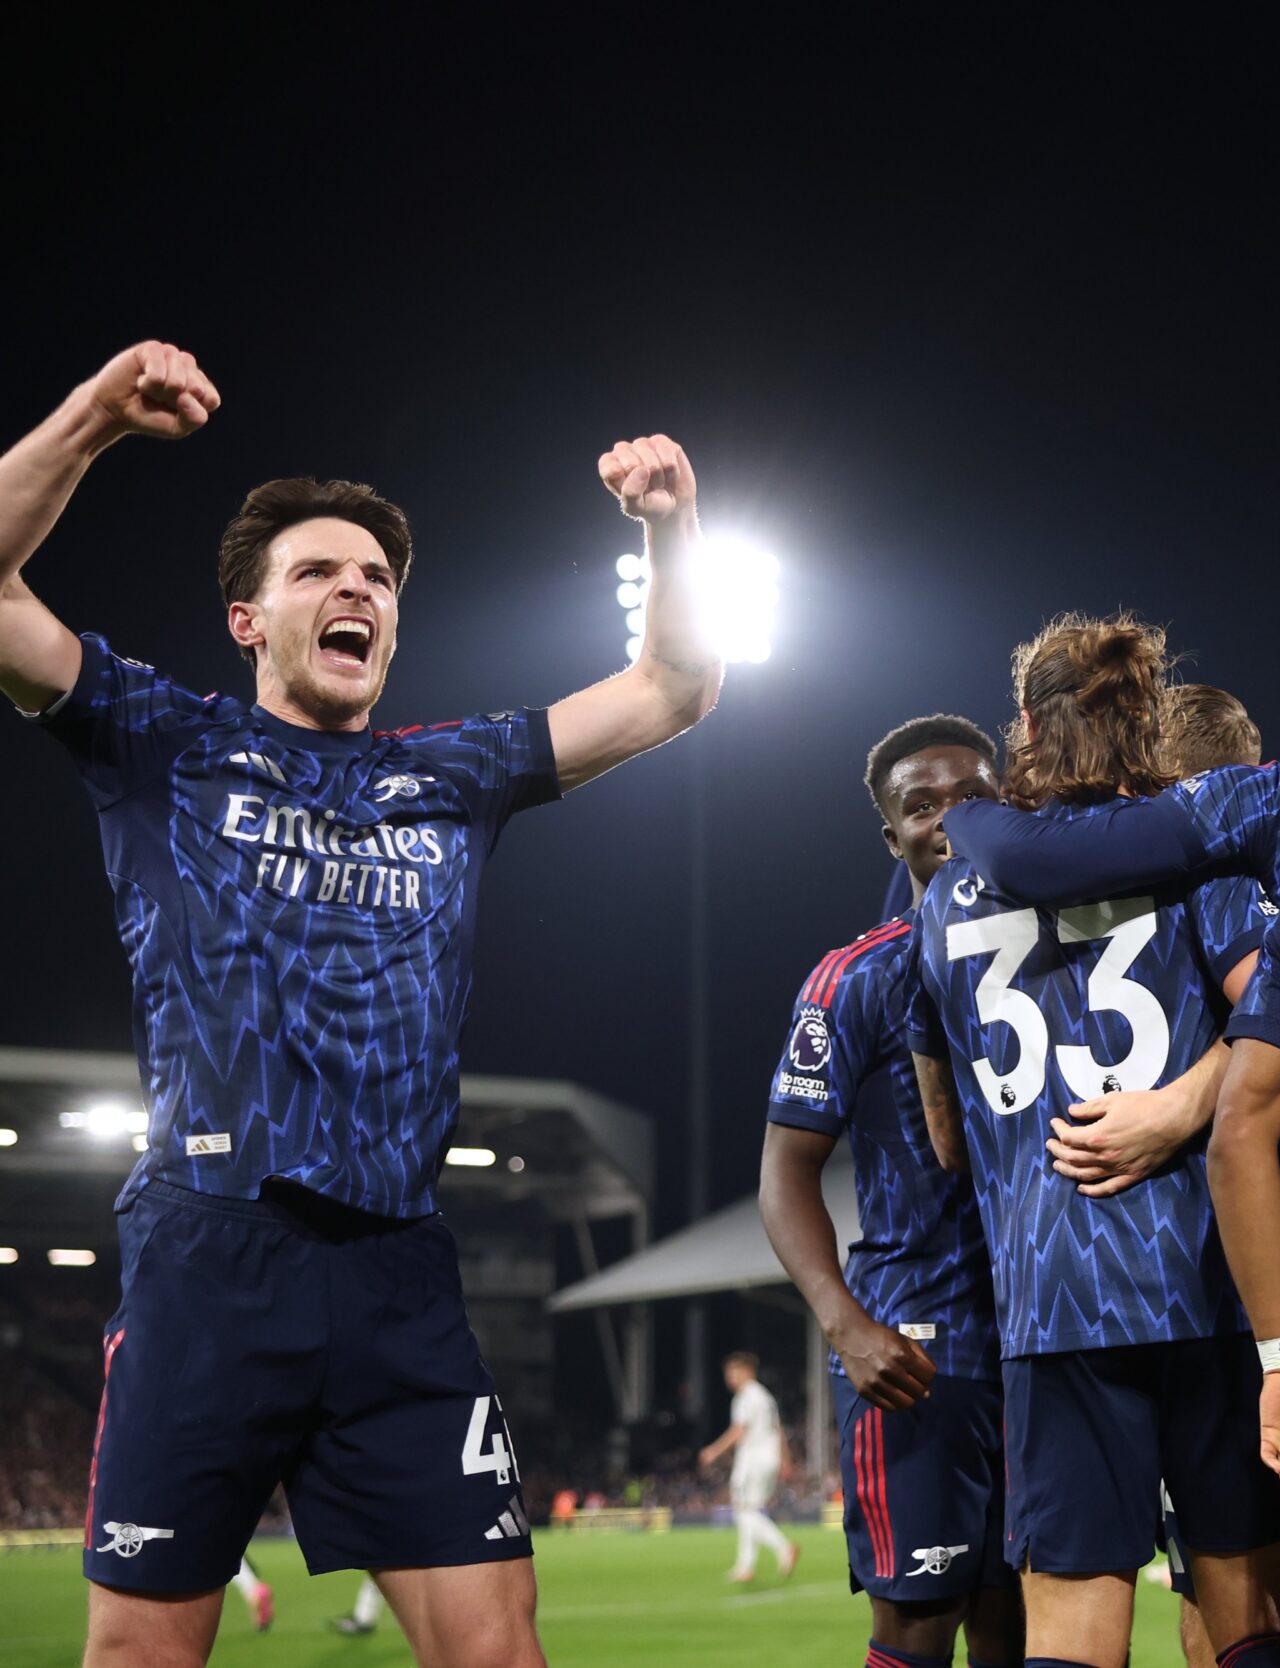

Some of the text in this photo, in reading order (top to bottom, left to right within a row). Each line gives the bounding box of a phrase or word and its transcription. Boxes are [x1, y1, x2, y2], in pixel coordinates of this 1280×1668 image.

[222, 793, 443, 866] Emirates
[256, 853, 420, 909] FLY BETTER
[946, 896, 1170, 1116] 33
[790, 1085, 829, 1100] racism
[793, 1075, 825, 1090] room
[461, 1394, 521, 1485] 4
